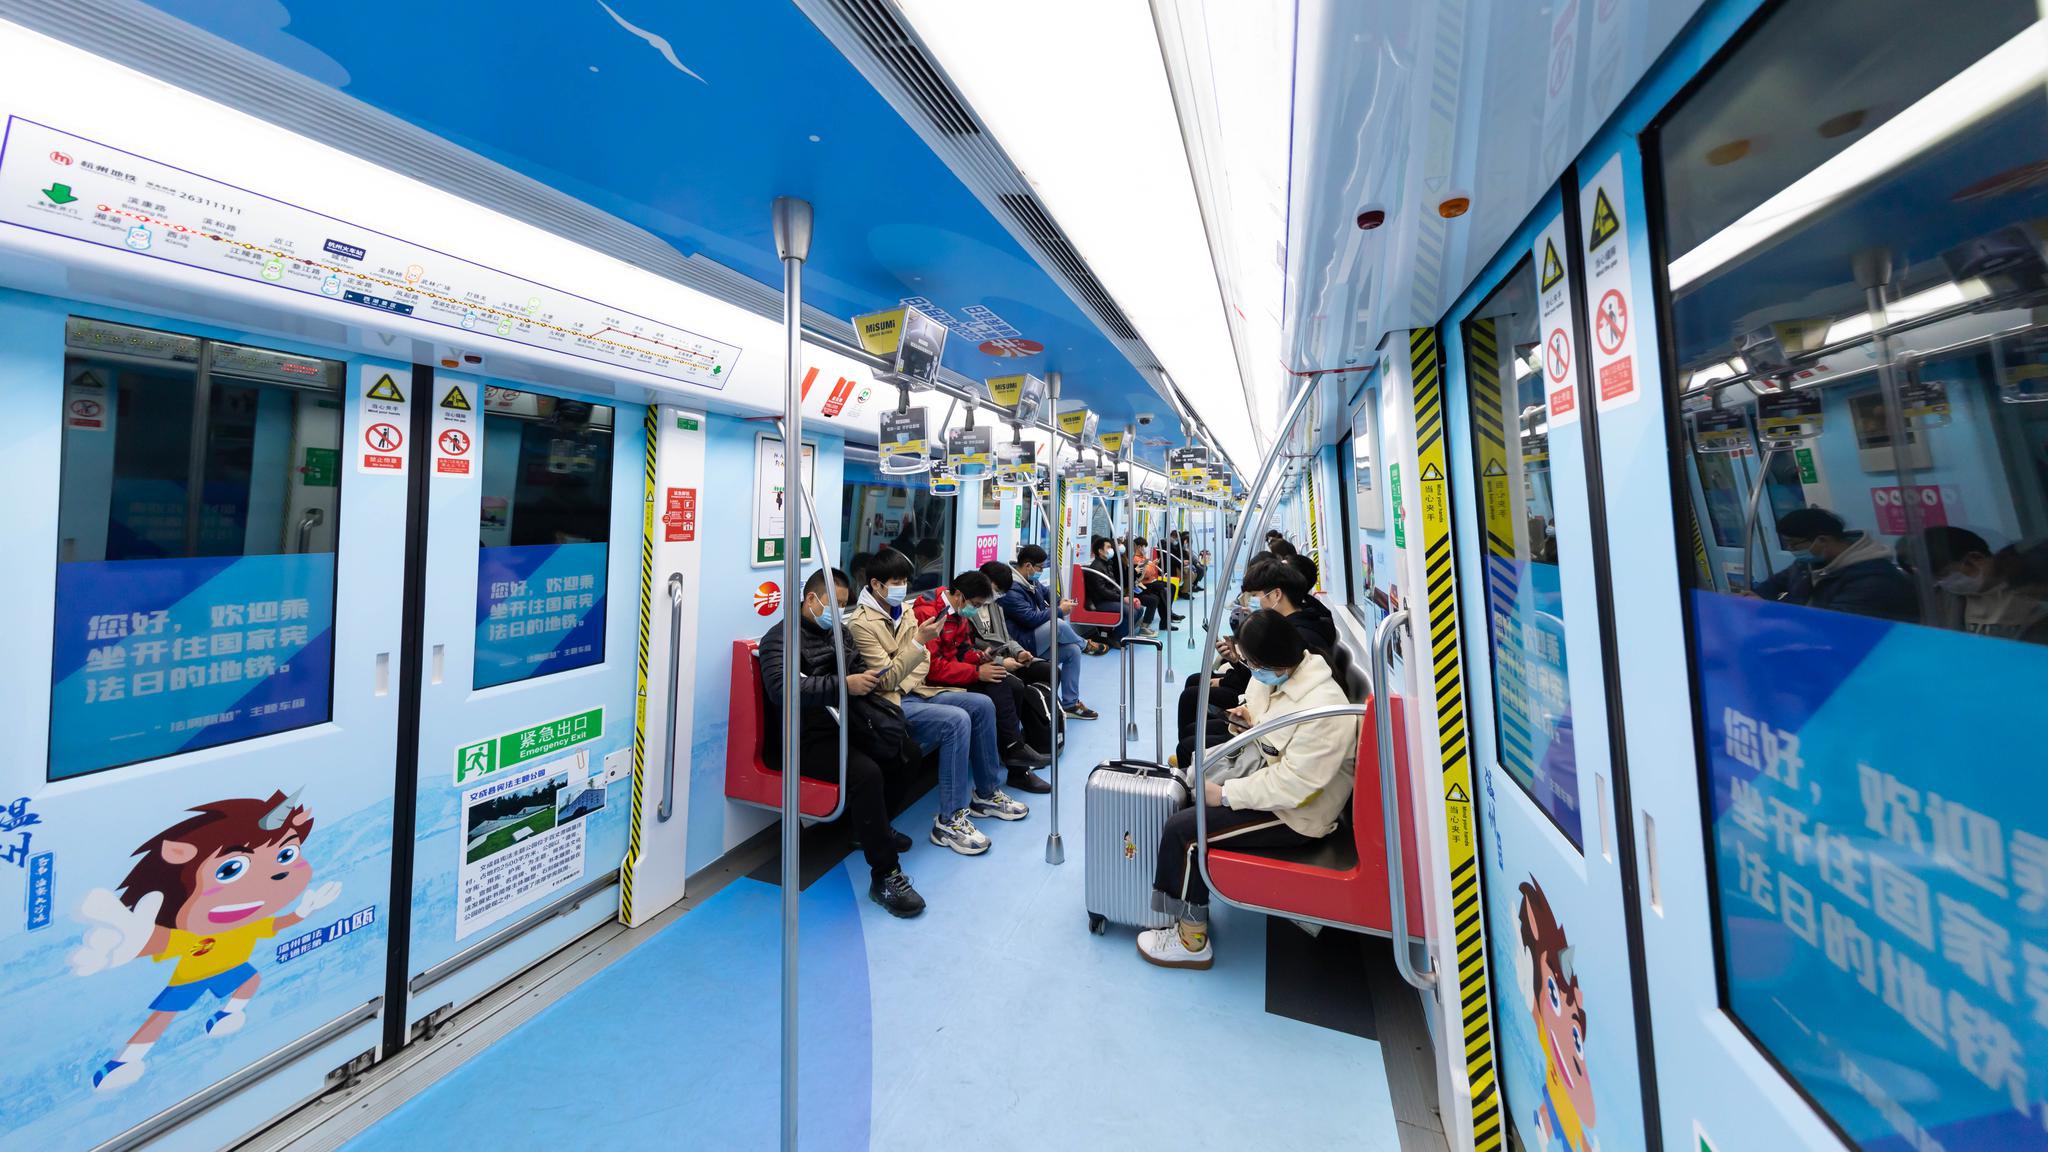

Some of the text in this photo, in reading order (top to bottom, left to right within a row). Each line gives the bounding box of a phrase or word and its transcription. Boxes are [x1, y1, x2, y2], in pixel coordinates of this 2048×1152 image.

[180, 191, 242, 216] 26311111
[1425, 485, 1435, 521] 当心夹手
[490, 574, 594, 600] 您好，欢迎乘
[87, 598, 310, 641] 您好，欢迎乘
[489, 613, 585, 641] 法日的地铁。
[84, 655, 290, 704] 法日的地铁。
[519, 715, 588, 750] 紧急出口
[519, 731, 587, 759] Emergency Exit
[1450, 805, 1461, 844] 当心夹手
[328, 906, 375, 941] 小瓯
[1737, 840, 2048, 1132] 法日的地铁
